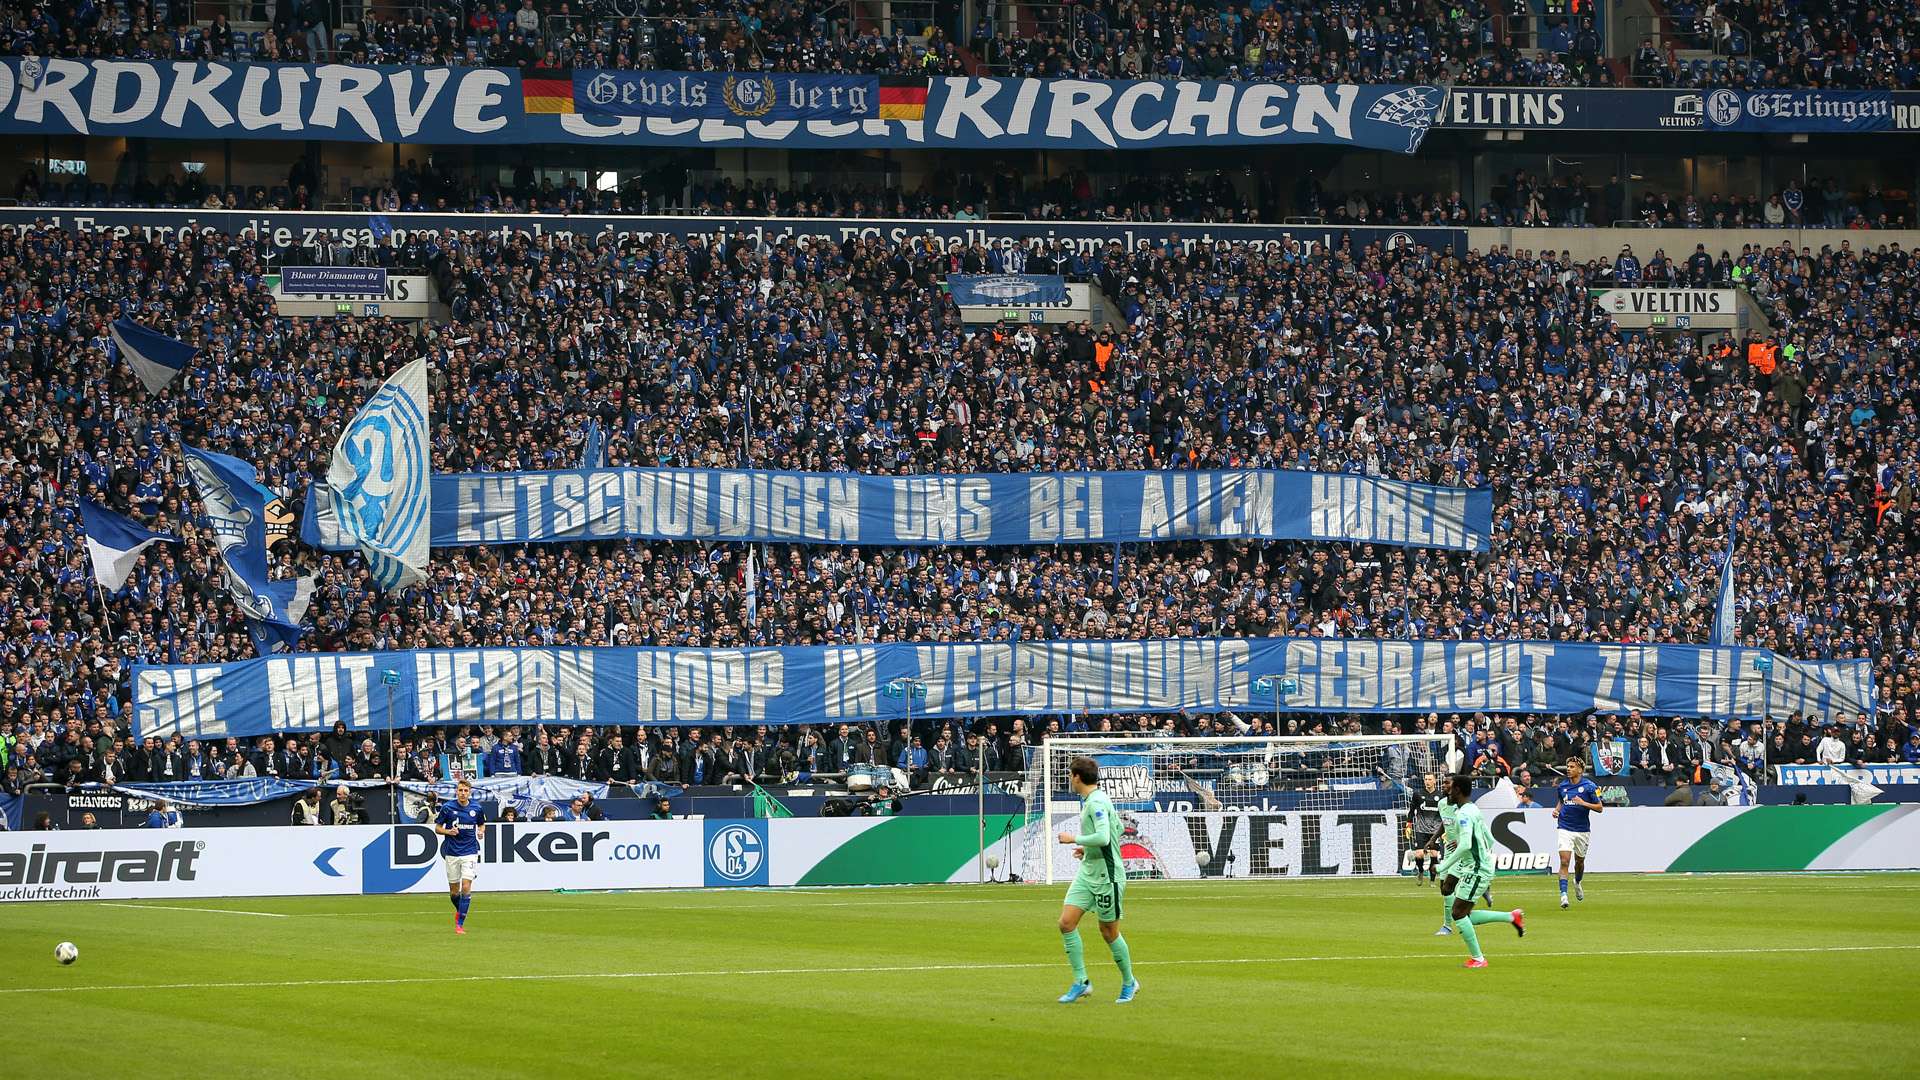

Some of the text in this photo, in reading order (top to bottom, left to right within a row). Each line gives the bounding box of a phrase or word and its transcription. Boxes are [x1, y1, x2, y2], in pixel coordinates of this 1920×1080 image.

[0, 60, 510, 143] RDKURVE
[788, 79, 869, 114] berg
[1747, 94, 1888, 123] GErlingen
[1659, 117, 1696, 127] VELTINS
[290, 271, 317, 279] Blaue
[319, 271, 366, 280] Diamanten
[1631, 292, 1720, 313] VELTINS
[1031, 311, 1043, 321] N4
[1677, 317, 1690, 327] N5
[457, 473, 860, 542] ENTSCHULDIGEN
[892, 476, 991, 542] UNS
[1029, 476, 1102, 541] BEI
[1139, 472, 1273, 538] ALLEN
[137, 667, 227, 738] SIE
[267, 656, 376, 730] MIT
[415, 649, 595, 722] HERRN
[637, 649, 784, 721] HOPP
[824, 648, 878, 718] IN
[919, 639, 1250, 711] VERBINDUNG
[1285, 641, 1555, 711] GEBRACHT
[1593, 647, 1659, 713] ZU
[69, 796, 122, 809] CHANGOS
[1095, 894, 1112, 909] 29
